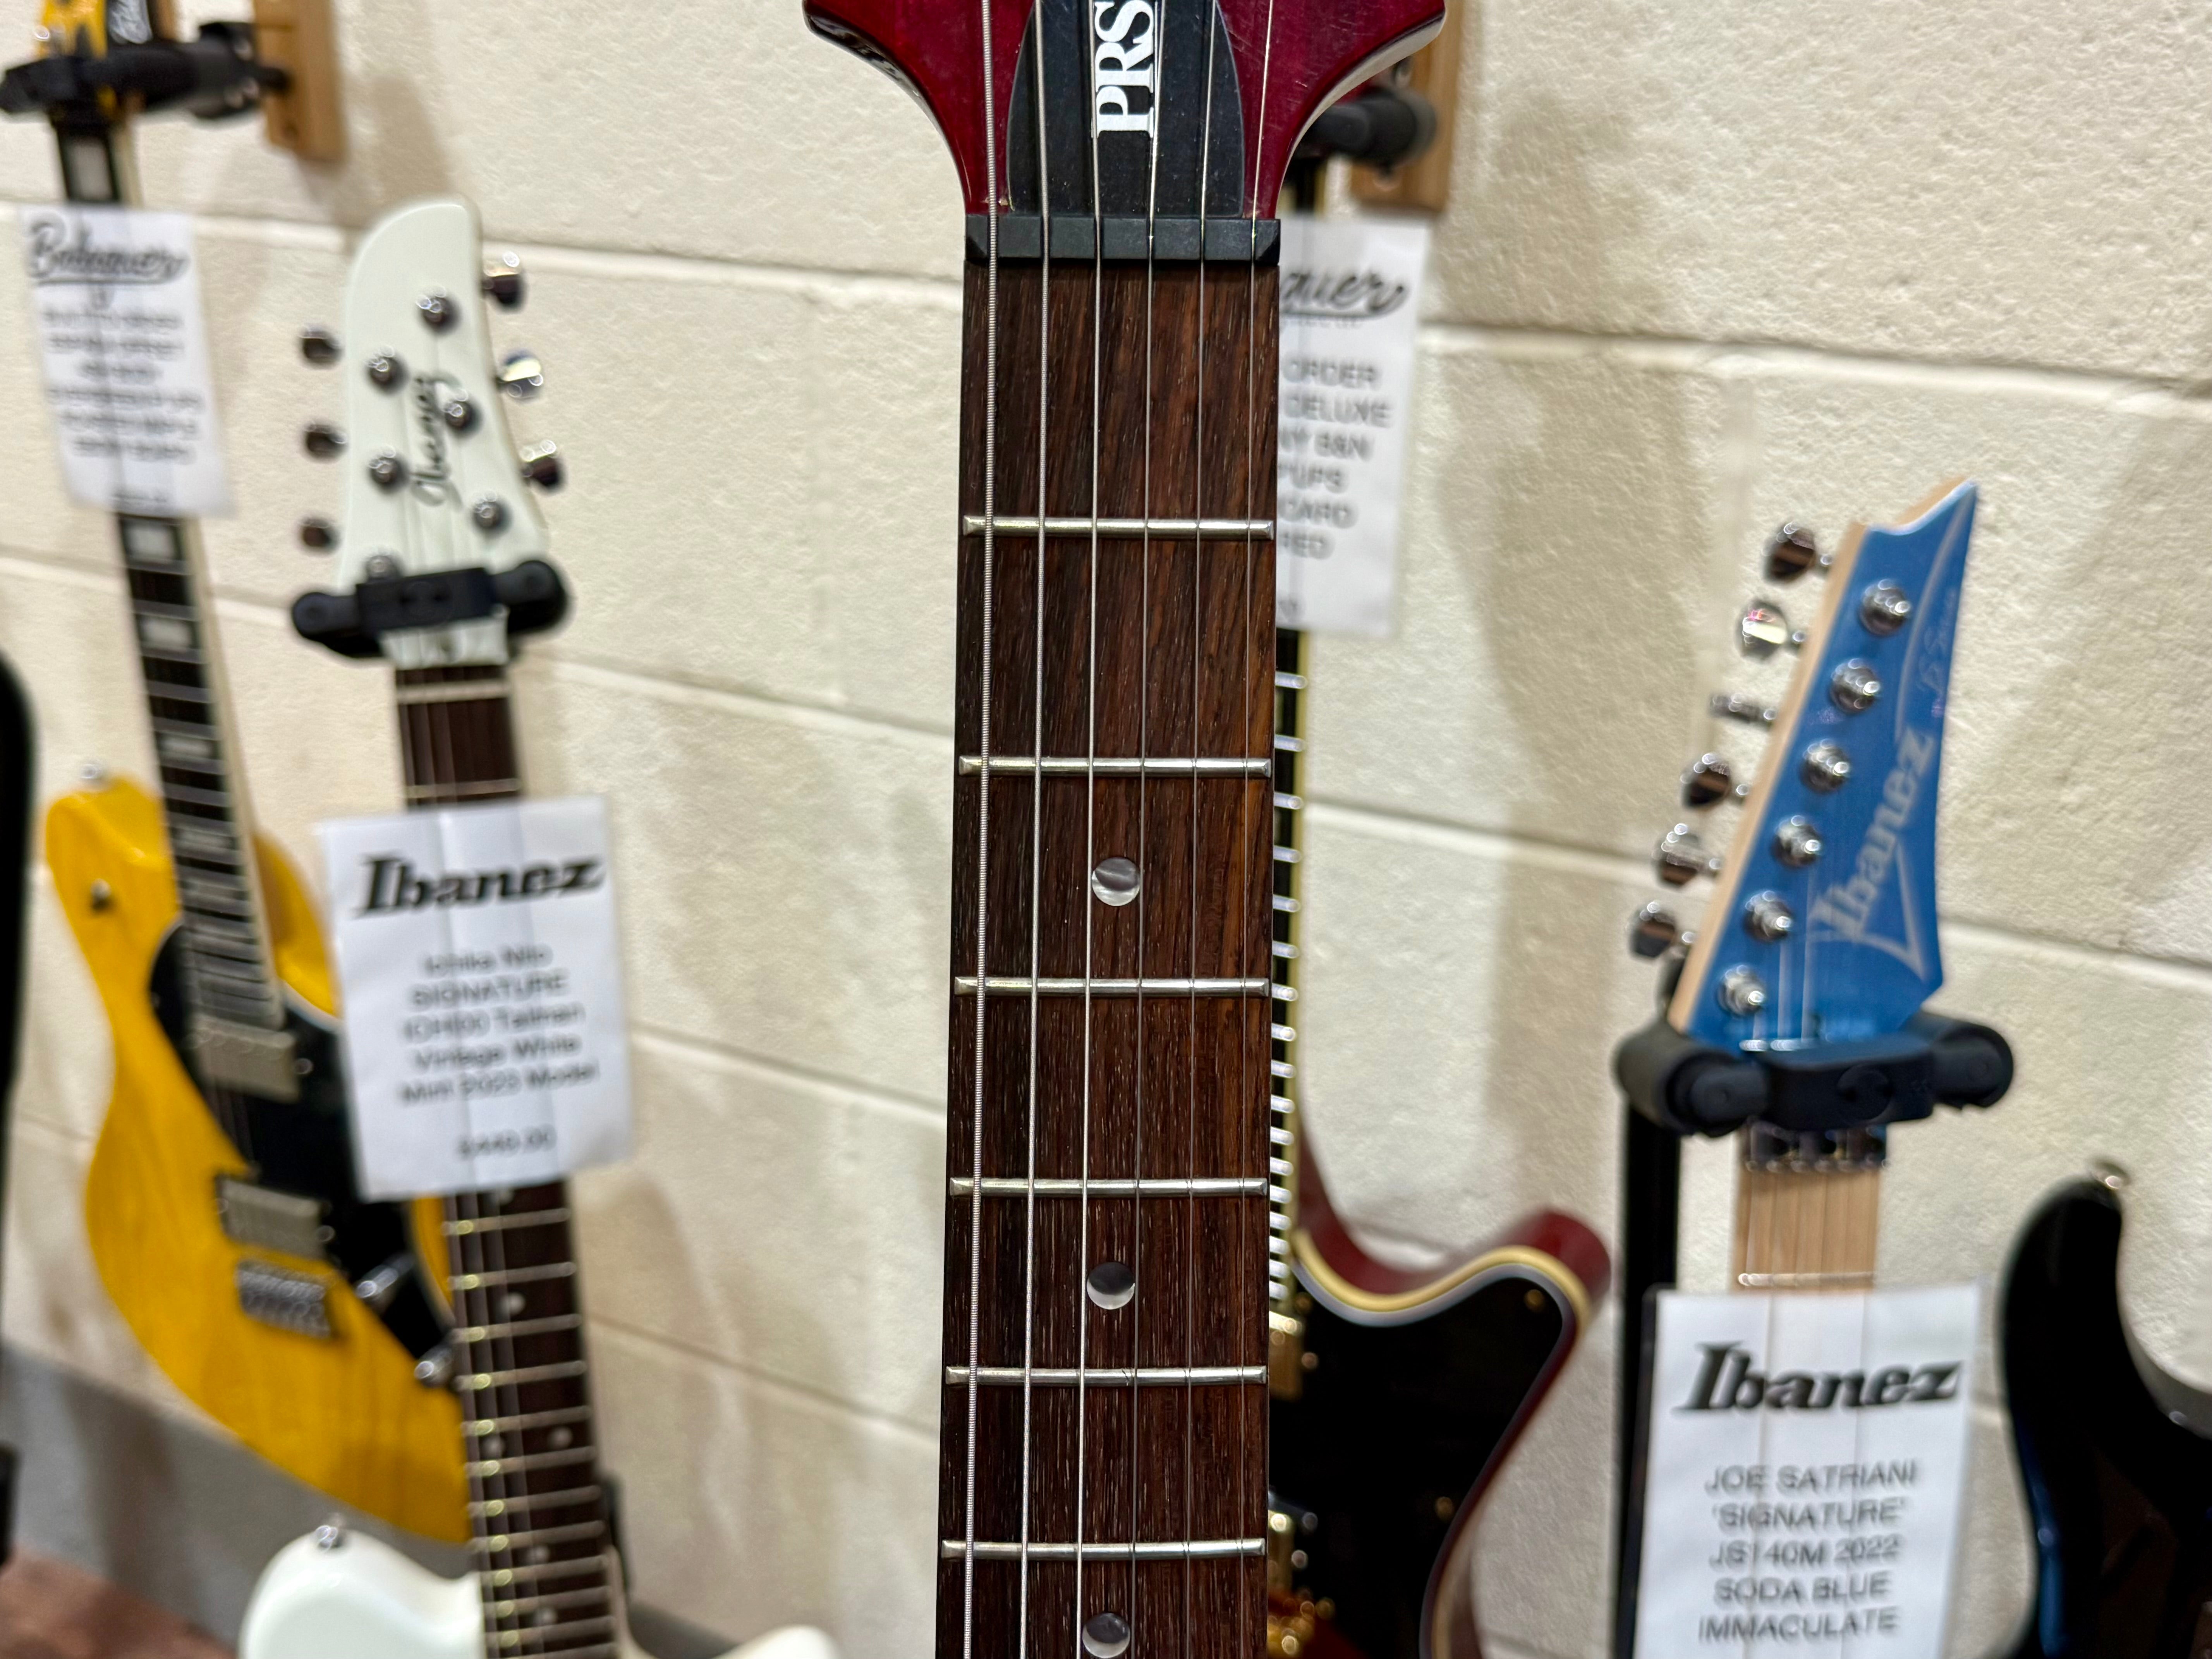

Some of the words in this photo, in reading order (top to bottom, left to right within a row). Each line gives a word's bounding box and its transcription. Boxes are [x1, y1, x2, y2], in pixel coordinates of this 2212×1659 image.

[1095, 0, 1155, 138] PRS
[1810, 726, 1936, 941] Ibanez
[353, 854, 606, 919] Ibanez
[411, 969, 568, 1007] SIGNATURE
[512, 1029, 582, 1058] White
[1673, 1340, 1964, 1413] Ibanez
[1706, 1466, 1767, 1494] JOE
[1776, 1459, 1919, 1493] SATRIANI
[1834, 1534, 1903, 1565] 2022
[1714, 1577, 1802, 1606] SODA
[1812, 1571, 1892, 1602] BLUE
[1698, 1606, 1900, 1645] IMMACULATE
